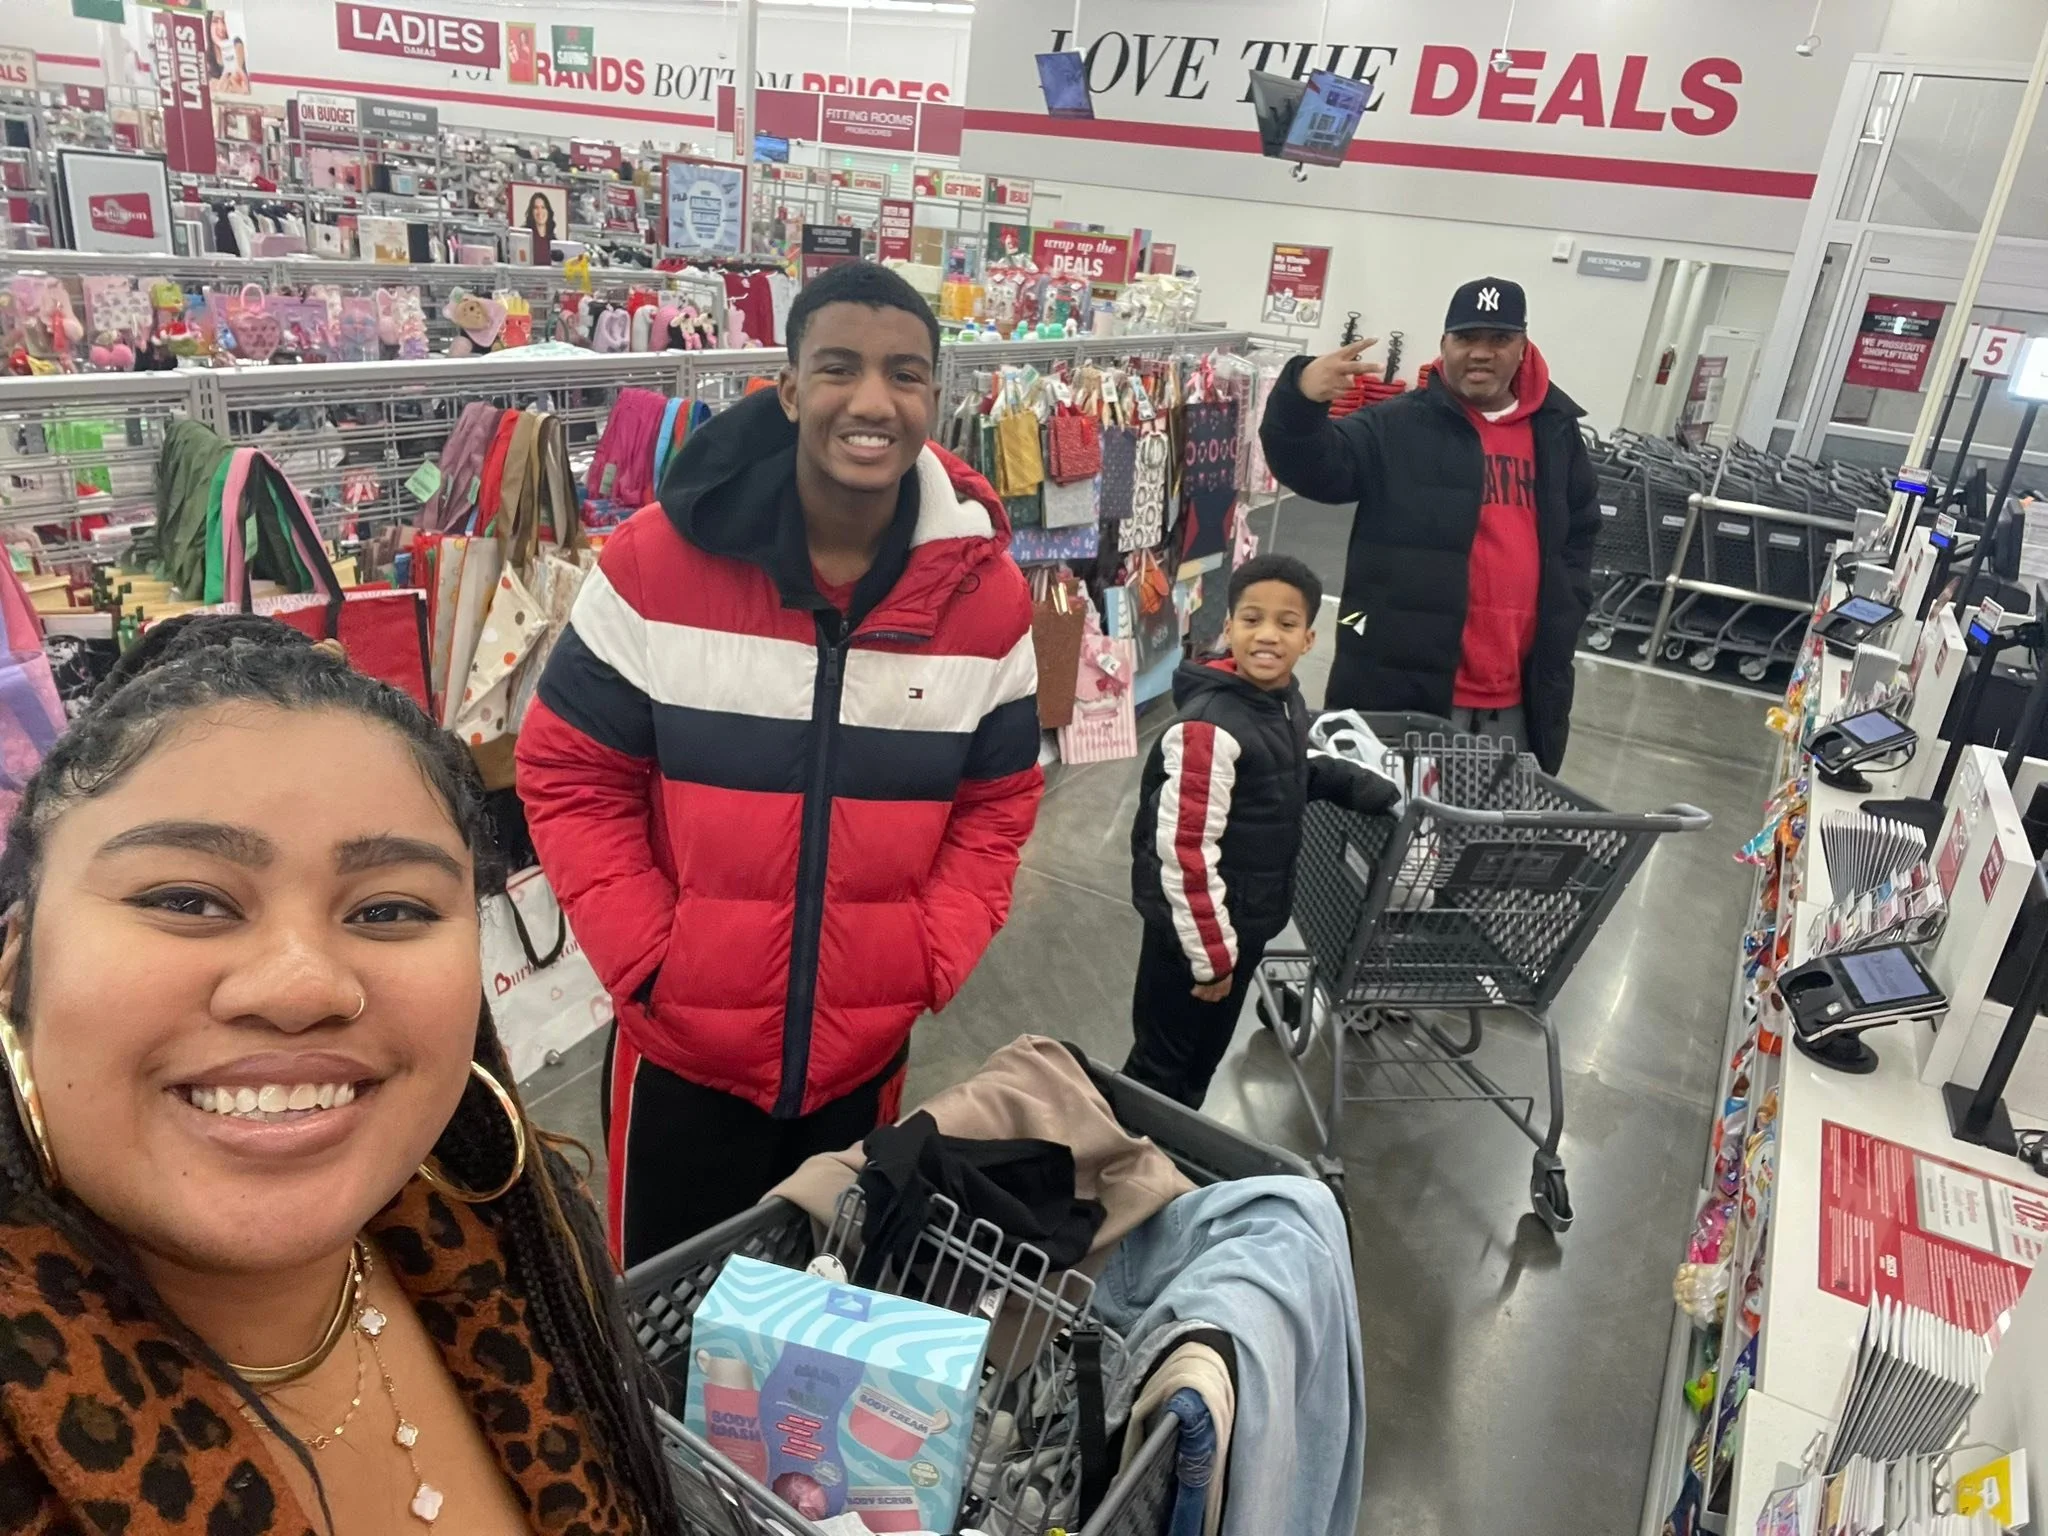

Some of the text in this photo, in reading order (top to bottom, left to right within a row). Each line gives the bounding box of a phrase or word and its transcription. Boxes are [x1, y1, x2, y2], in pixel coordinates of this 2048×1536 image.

[352, 8, 485, 54] LADIES
[403, 46, 436, 57] DAMAS
[155, 22, 174, 107] LADIES
[175, 25, 203, 110] LADIES
[537, 52, 646, 95] RNDS
[1410, 44, 1743, 137] DEALS
[301, 103, 356, 125] ON BUDGET
[826, 107, 914, 126] FITTING ROOMS
[944, 182, 982, 198] GIFTING
[1043, 238, 1117, 255] wrap up the
[1053, 254, 1104, 278] DEALS
[1862, 337, 1927, 353] WE PROSECUTE
[1863, 346, 1919, 361] SHOPLIFTERS
[1983, 336, 2008, 366] 5
[711, 1410, 758, 1428] BODY
[861, 1394, 929, 1434] BODY CREAM
[711, 1423, 761, 1441] WASH
[878, 1496, 913, 1505] SCRUB
